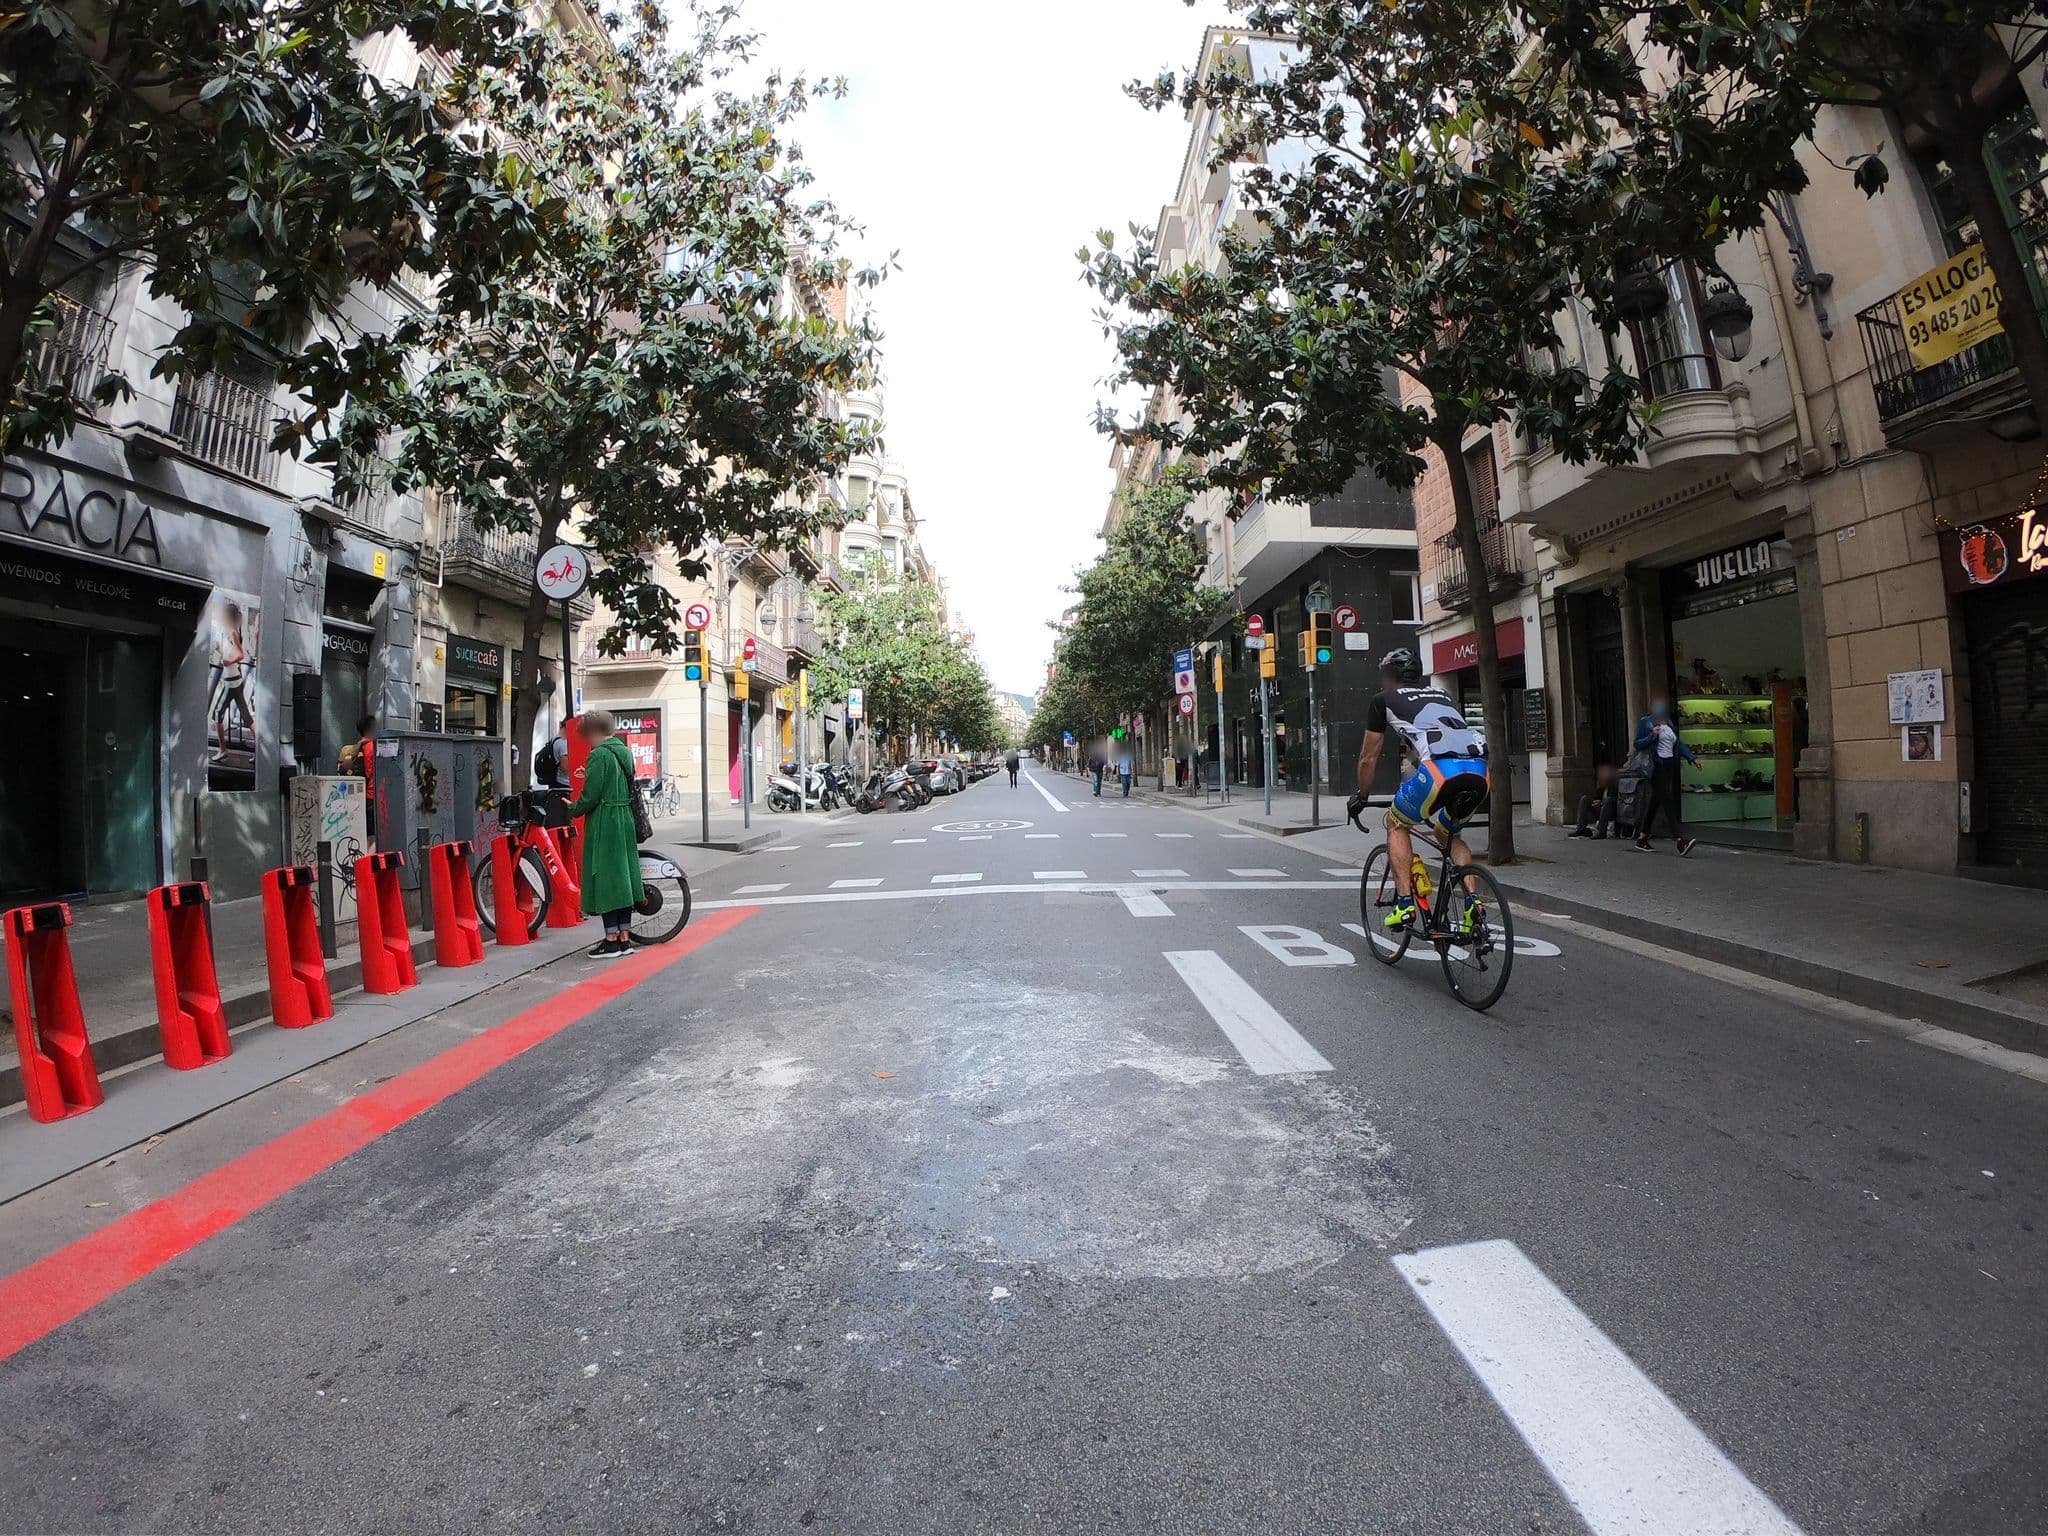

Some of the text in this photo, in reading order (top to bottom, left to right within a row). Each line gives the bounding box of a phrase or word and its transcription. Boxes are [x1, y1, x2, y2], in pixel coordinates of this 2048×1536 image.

[1901, 287, 1926, 315] ES
[1909, 321, 1929, 347] 93
[1931, 305, 1958, 335] 485
[1961, 294, 1981, 321] 20
[1981, 285, 2004, 310] 20
[1695, 541, 1771, 587] HUELLA
[75, 578, 132, 599] WELCOME
[157, 596, 187, 611] dir.cat
[1453, 643, 1478, 660] MAC
[956, 821, 1009, 829] 30
